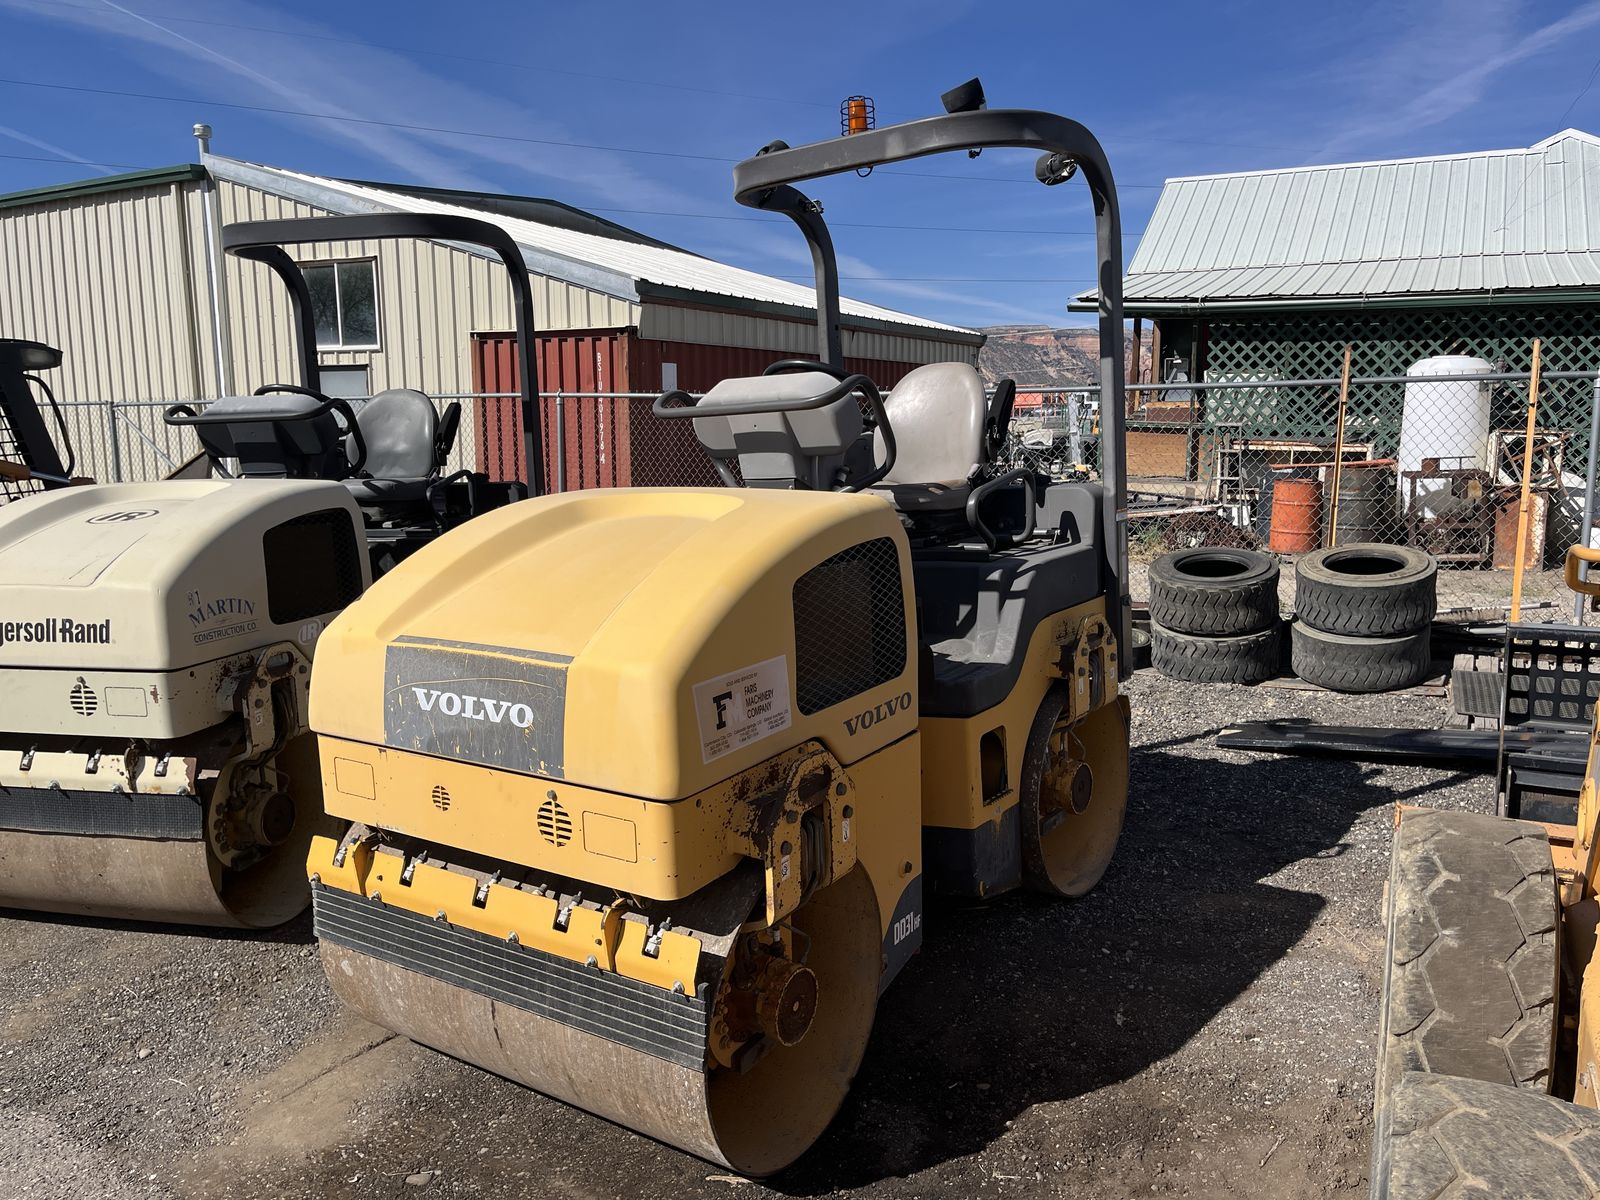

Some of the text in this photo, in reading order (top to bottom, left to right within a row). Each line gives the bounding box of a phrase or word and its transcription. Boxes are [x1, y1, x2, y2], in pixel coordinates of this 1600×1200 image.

[188, 597, 256, 628] MARTIN
[193, 624, 245, 643] CONSTRUCTION
[744, 683, 757, 696] FARIS
[745, 688, 774, 707] MACHINERY
[411, 686, 534, 728] VOLVO
[746, 701, 772, 718] COMPANY
[843, 691, 912, 737] VOLVO
